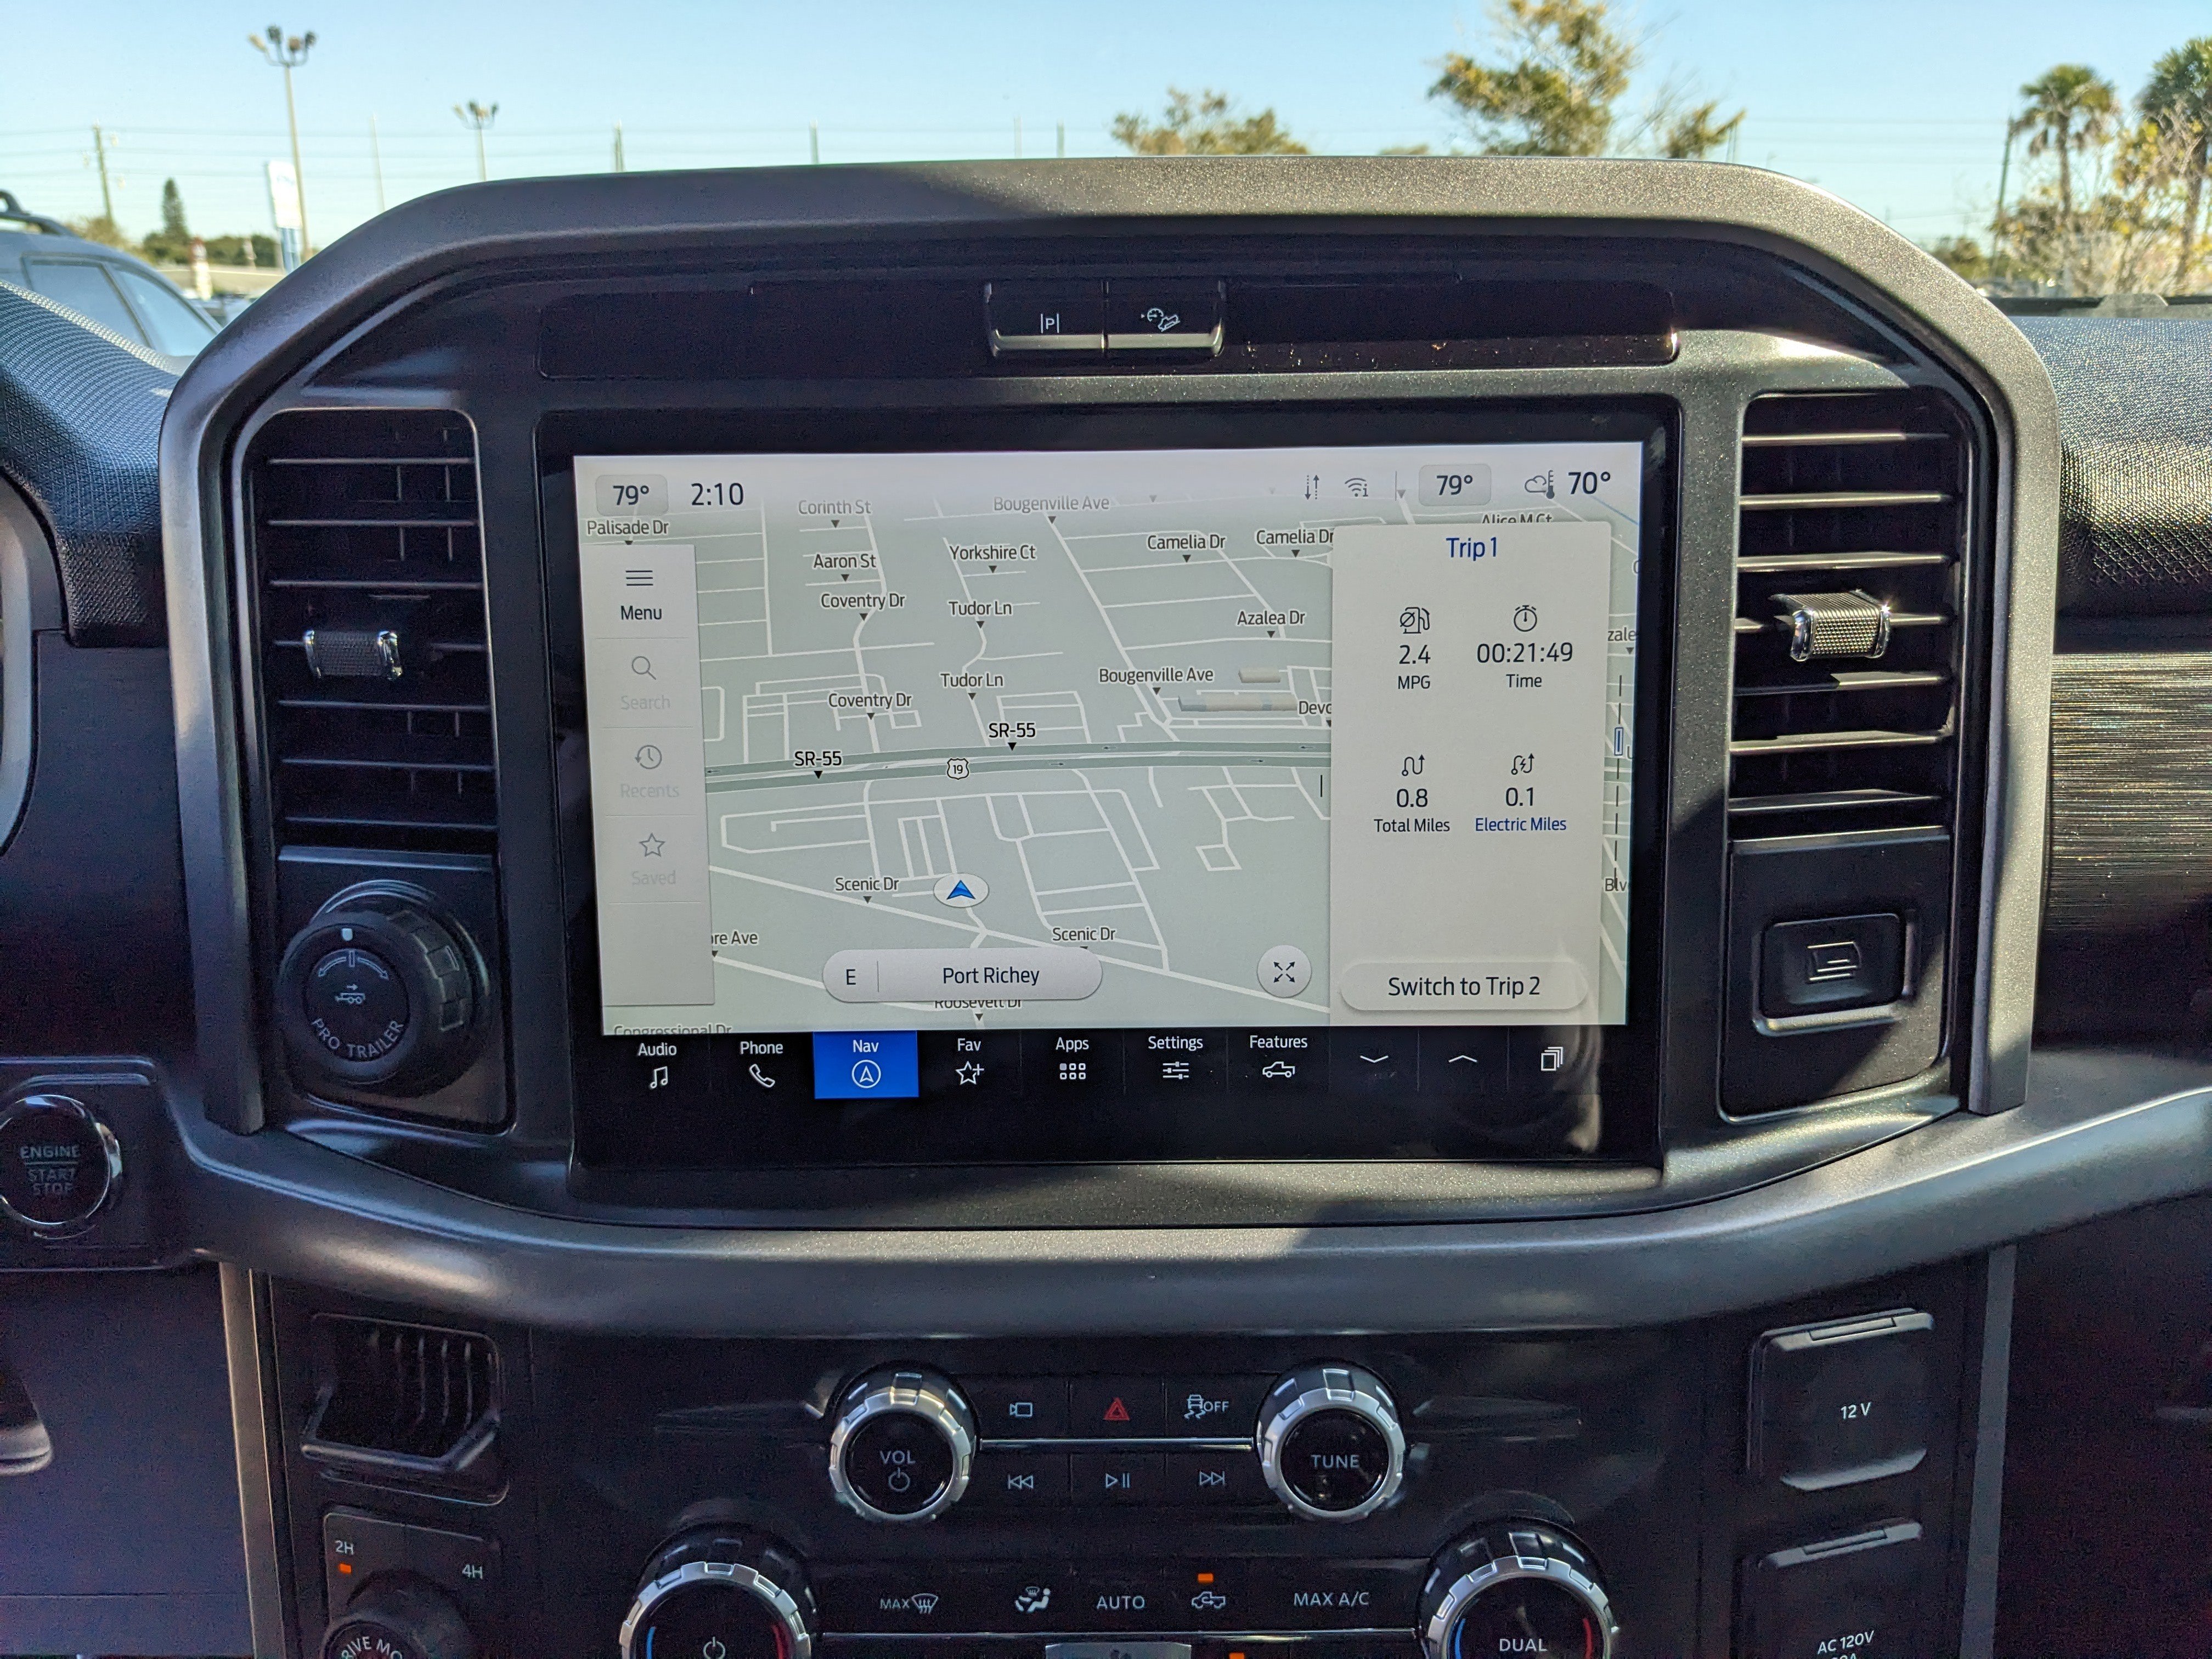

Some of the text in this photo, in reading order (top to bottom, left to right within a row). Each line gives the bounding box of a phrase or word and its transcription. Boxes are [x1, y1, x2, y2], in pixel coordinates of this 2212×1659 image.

[691, 483, 744, 506] 2:10
[798, 500, 871, 515] Corinth St
[994, 496, 1110, 512] Bougenville Ave
[588, 520, 669, 535] Palisade Dr
[1148, 534, 1226, 549] Camelia Dr
[1256, 529, 1334, 544] Camelia Dr
[950, 545, 1036, 560] Yorkshire Ct
[1446, 537, 1497, 561] Trip 1
[814, 554, 876, 568] Aaron St
[821, 594, 905, 610] Coventry Dr
[949, 601, 1012, 615] Tudor Ln
[620, 606, 663, 621] Menu
[1237, 611, 1305, 625] Azalea Dr
[1398, 645, 1431, 664] 2.4
[1476, 642, 1573, 663] 00:21:49
[940, 673, 1003, 687] Tudor Ln
[1099, 669, 1214, 685] Bougenville Ave
[1397, 675, 1431, 690] MPG
[1506, 674, 1542, 688] Time
[620, 695, 671, 710] Search
[828, 693, 912, 710] Coventry Dr
[988, 723, 1036, 738] SR-55
[794, 751, 843, 766] SR-55
[952, 764, 964, 775] 19
[620, 783, 680, 799] Recents
[1396, 788, 1429, 808] 0.8
[1505, 787, 1535, 807] 0.1
[1374, 818, 1451, 833] Total Miles
[1475, 817, 1567, 832] Electric Miles
[631, 870, 676, 885] Saved
[834, 877, 899, 891] Scenic Dr
[731, 930, 758, 945] Ave
[1052, 927, 1116, 941] Scenic Dr
[846, 969, 856, 985] E
[943, 966, 1040, 986] Port Richey
[1387, 976, 1541, 999] Switch to Trip 2
[311, 1018, 404, 1059] PRO TRAILER
[957, 1038, 981, 1052] Fav
[1055, 1036, 1089, 1052] Apps
[1148, 1035, 1204, 1051] Settings
[1249, 1034, 1308, 1049] Features
[637, 1042, 678, 1057] Audio
[740, 1041, 783, 1055] Phone
[853, 1040, 879, 1053] Nav
[20, 1145, 80, 1159] ENGINE
[27, 1168, 76, 1182] START
[32, 1182, 74, 1195] STOP
[1203, 1401, 1229, 1412] OFF
[1841, 1402, 1872, 1420] 12 V
[879, 1450, 916, 1464] VOL
[1311, 1455, 1360, 1469] TUNE
[335, 1539, 354, 1555] 2H
[461, 1564, 483, 1580] 4H
[879, 1598, 910, 1610] MAX
[1096, 1595, 1146, 1610] AUTO
[1293, 1592, 1370, 1606] MAX A/C
[1499, 1638, 1548, 1652] DUAL
[1818, 1630, 1875, 1654] AC 120V
